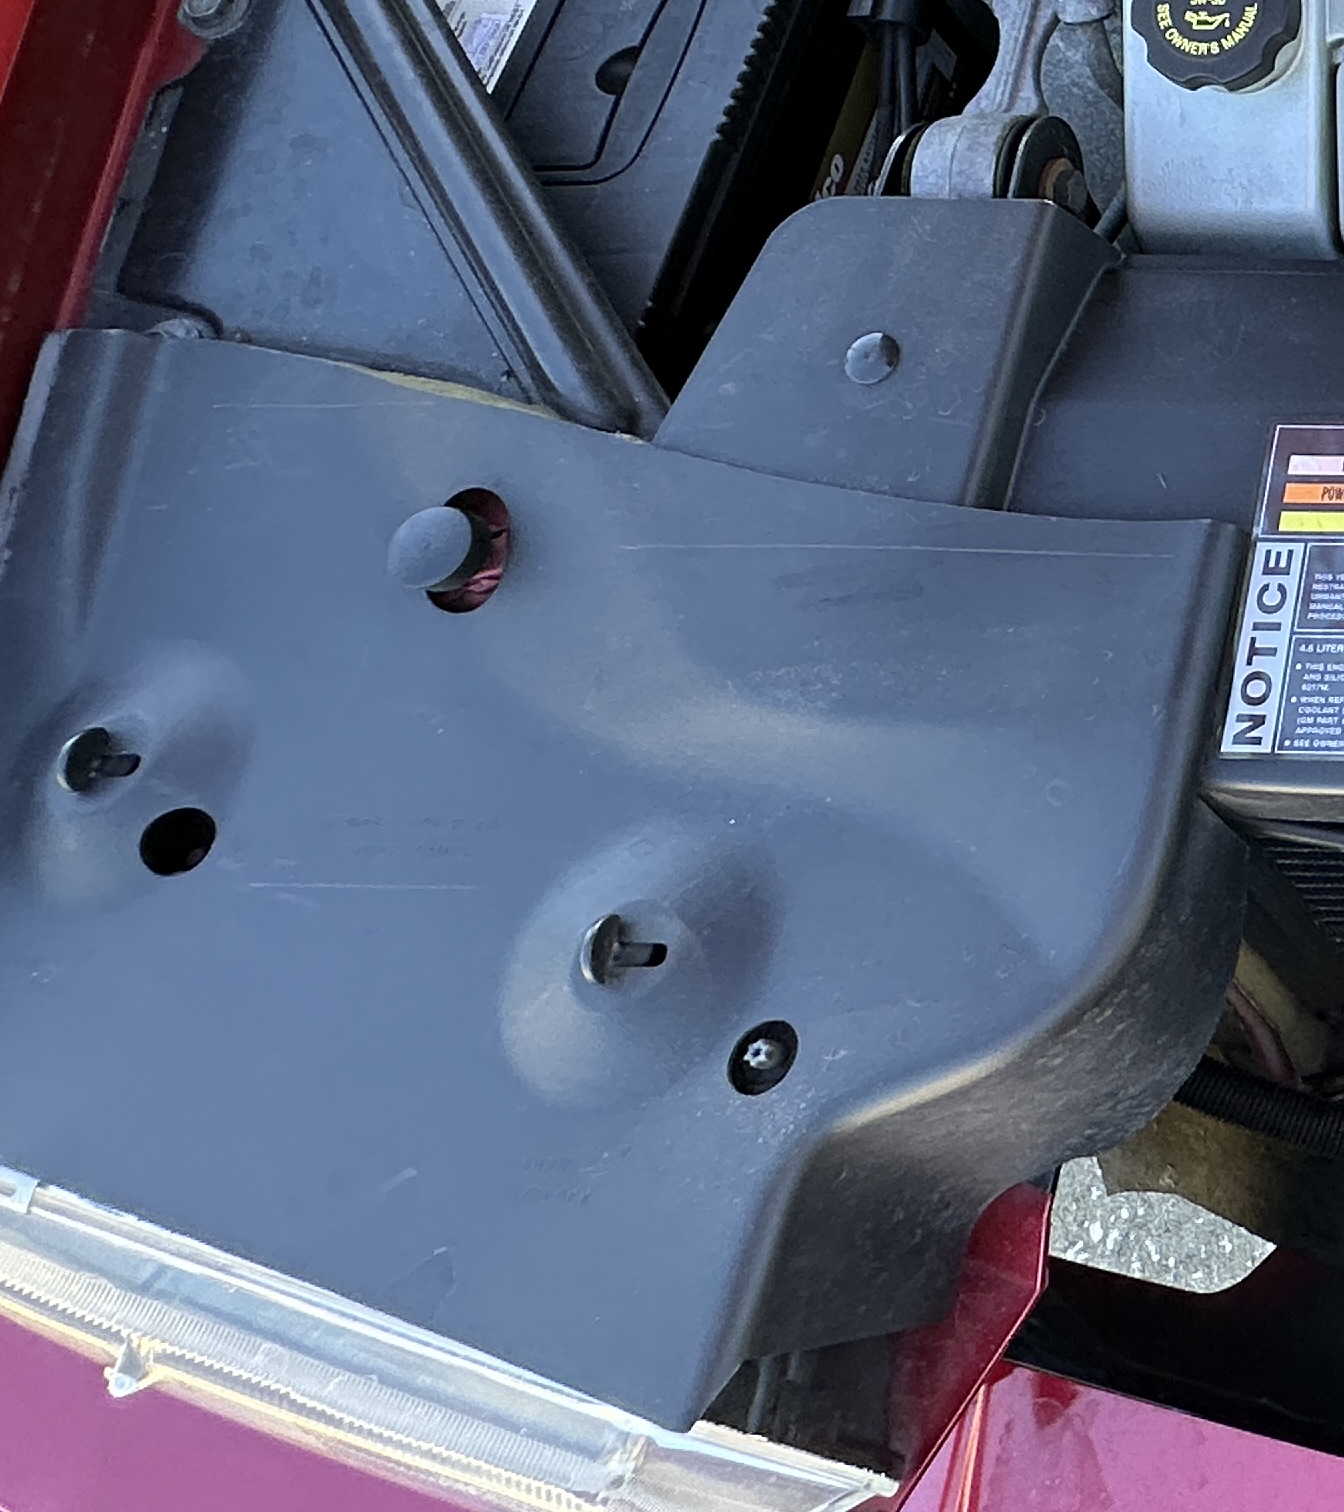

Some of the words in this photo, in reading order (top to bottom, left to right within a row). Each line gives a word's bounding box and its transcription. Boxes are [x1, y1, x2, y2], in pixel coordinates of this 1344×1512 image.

[1157, 3, 1173, 29] SEE
[1165, 28, 1220, 55] OWNER'S
[1220, 3, 1258, 50] MANUAL
[1230, 548, 1295, 747] NOTICE
